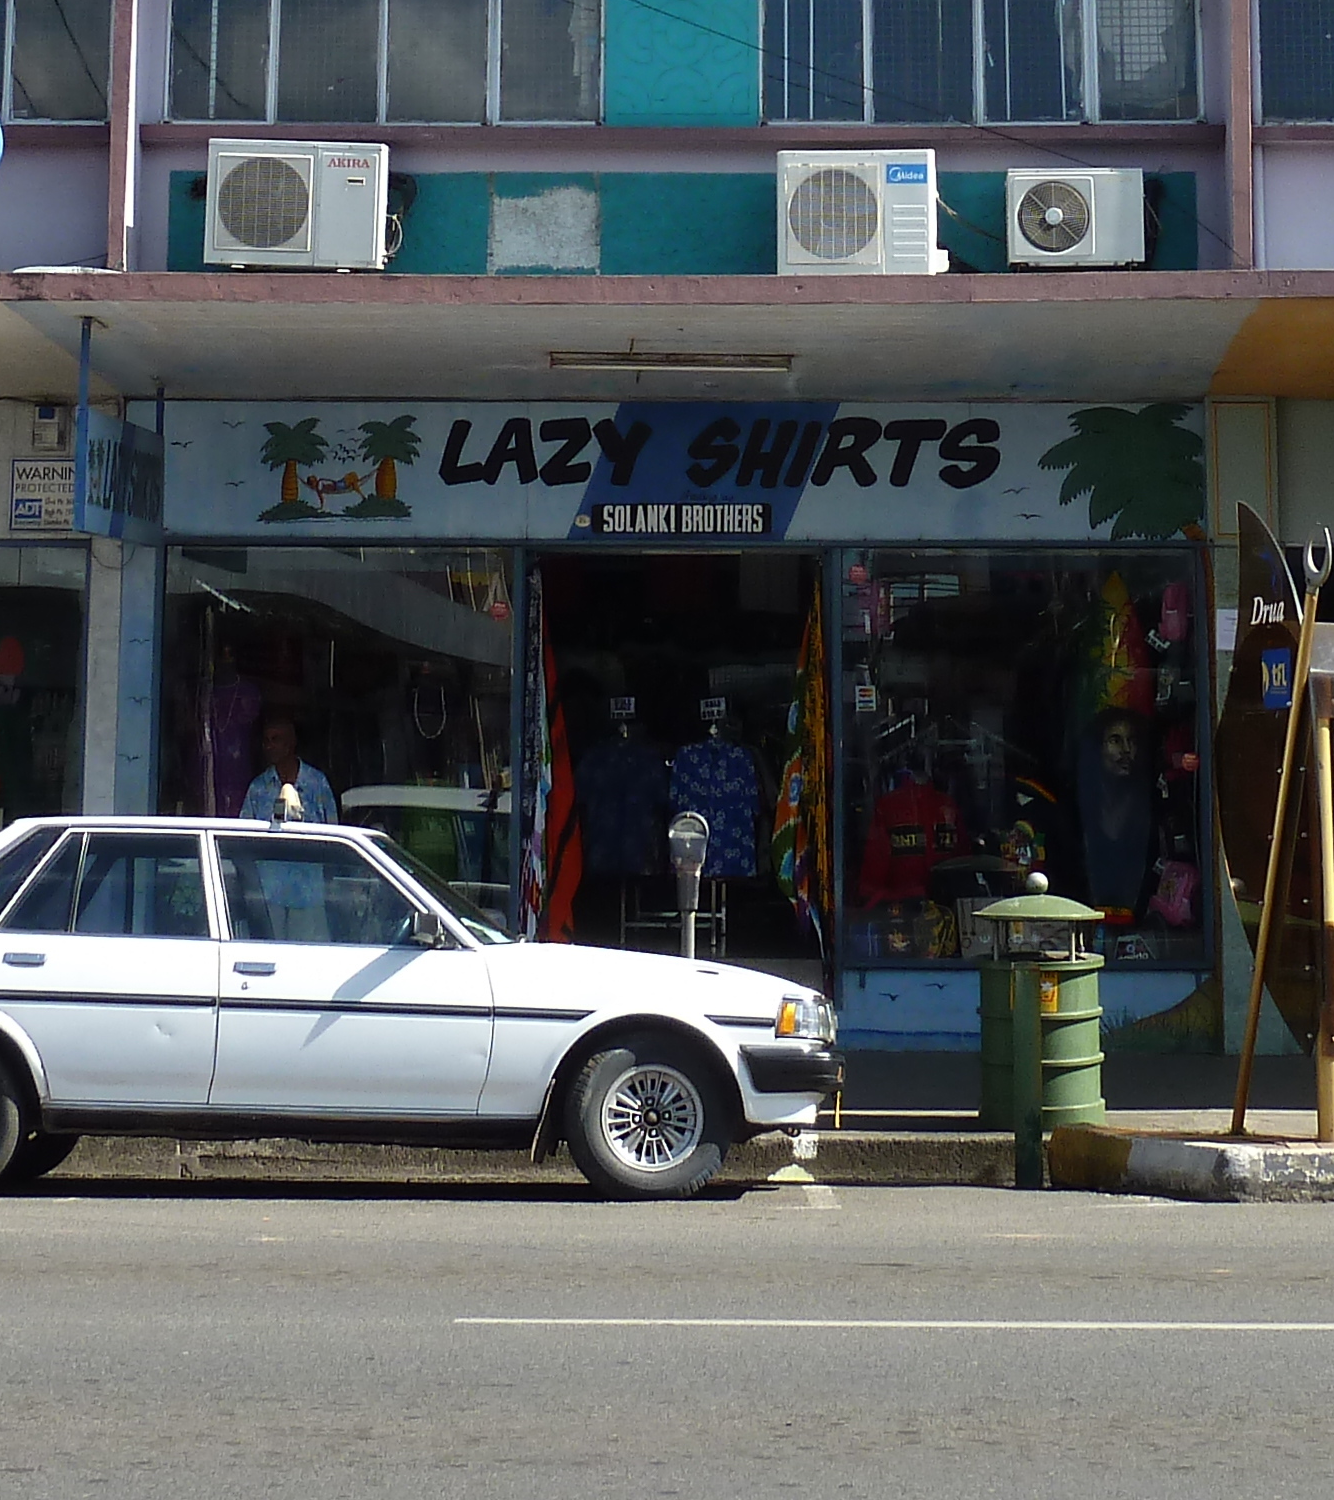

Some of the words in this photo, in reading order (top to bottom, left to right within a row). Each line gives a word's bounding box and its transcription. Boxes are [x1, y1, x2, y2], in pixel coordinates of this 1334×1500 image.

[327, 157, 370, 169] AKIRA
[438, 417, 652, 487] LAZY
[686, 417, 1002, 489] SHIRTS
[16, 466, 75, 482] WARNIN
[14, 501, 42, 517] ADT
[603, 505, 676, 533] SOLANKI
[682, 505, 764, 533] BROTHERS
[1250, 596, 1285, 625] Drua
